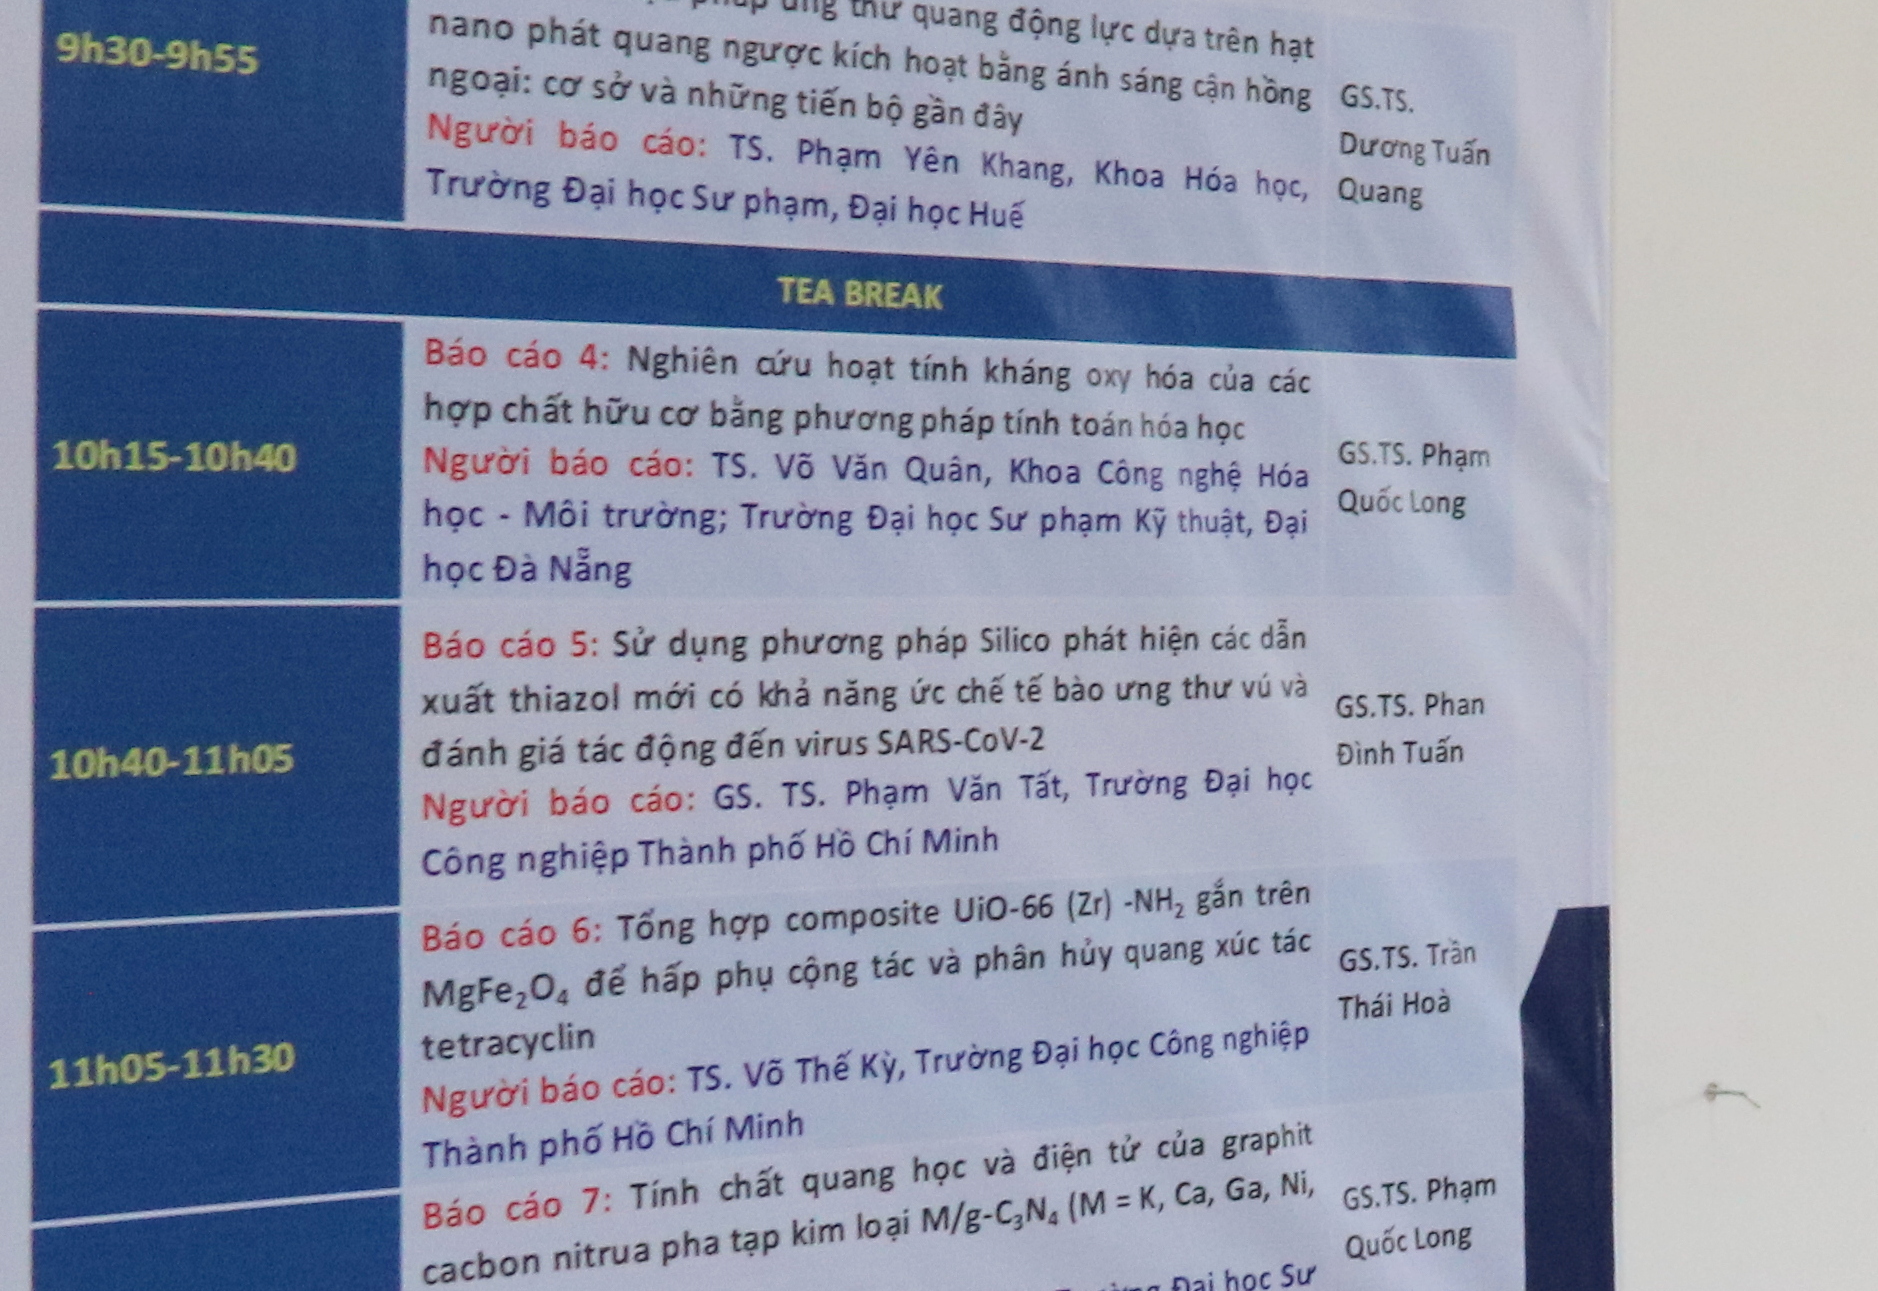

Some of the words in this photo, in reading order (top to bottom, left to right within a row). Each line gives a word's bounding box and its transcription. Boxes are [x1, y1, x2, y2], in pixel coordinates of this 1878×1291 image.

[57, 31, 258, 75] 9h30-9h55
[425, 167, 551, 209] Trường
[562, 175, 615, 209] Đại
[628, 178, 684, 214] học
[692, 183, 735, 212] Sư
[744, 186, 838, 223] phạm,
[847, 193, 897, 226] Đại
[908, 195, 961, 230] học
[969, 199, 1025, 229] Huế
[776, 275, 835, 304] TEA
[845, 278, 942, 309] BREAK
[53, 439, 296, 473] 10h15-10h40
[423, 553, 484, 589] học
[492, 554, 537, 583] Đà
[1335, 692, 1414, 719] GS.TS.
[1425, 690, 1485, 716] Phan
[51, 742, 294, 780] 10h40-11h05
[421, 736, 507, 768] đánh
[519, 735, 565, 773] giá
[577, 733, 624, 763] tác
[635, 731, 716, 767] động
[725, 727, 785, 760] đến
[795, 729, 868, 758] virus
[877, 725, 1045, 755] SARS-CoV-2
[1336, 739, 1395, 766] Đình
[1402, 735, 1464, 764] Tuấn
[421, 1021, 595, 1061] tetracyclin
[49, 1041, 295, 1089] 11h05-11h30
[422, 1133, 527, 1168] Thành
[613, 1121, 655, 1151] Hồ
[666, 1115, 714, 1147] Chí
[725, 1109, 804, 1142] Minh
[1343, 1179, 1417, 1211] GS.TS.
[1427, 1175, 1496, 1203] Phạm
[1345, 1226, 1408, 1261] Quốc
[1414, 1226, 1473, 1251] Long
